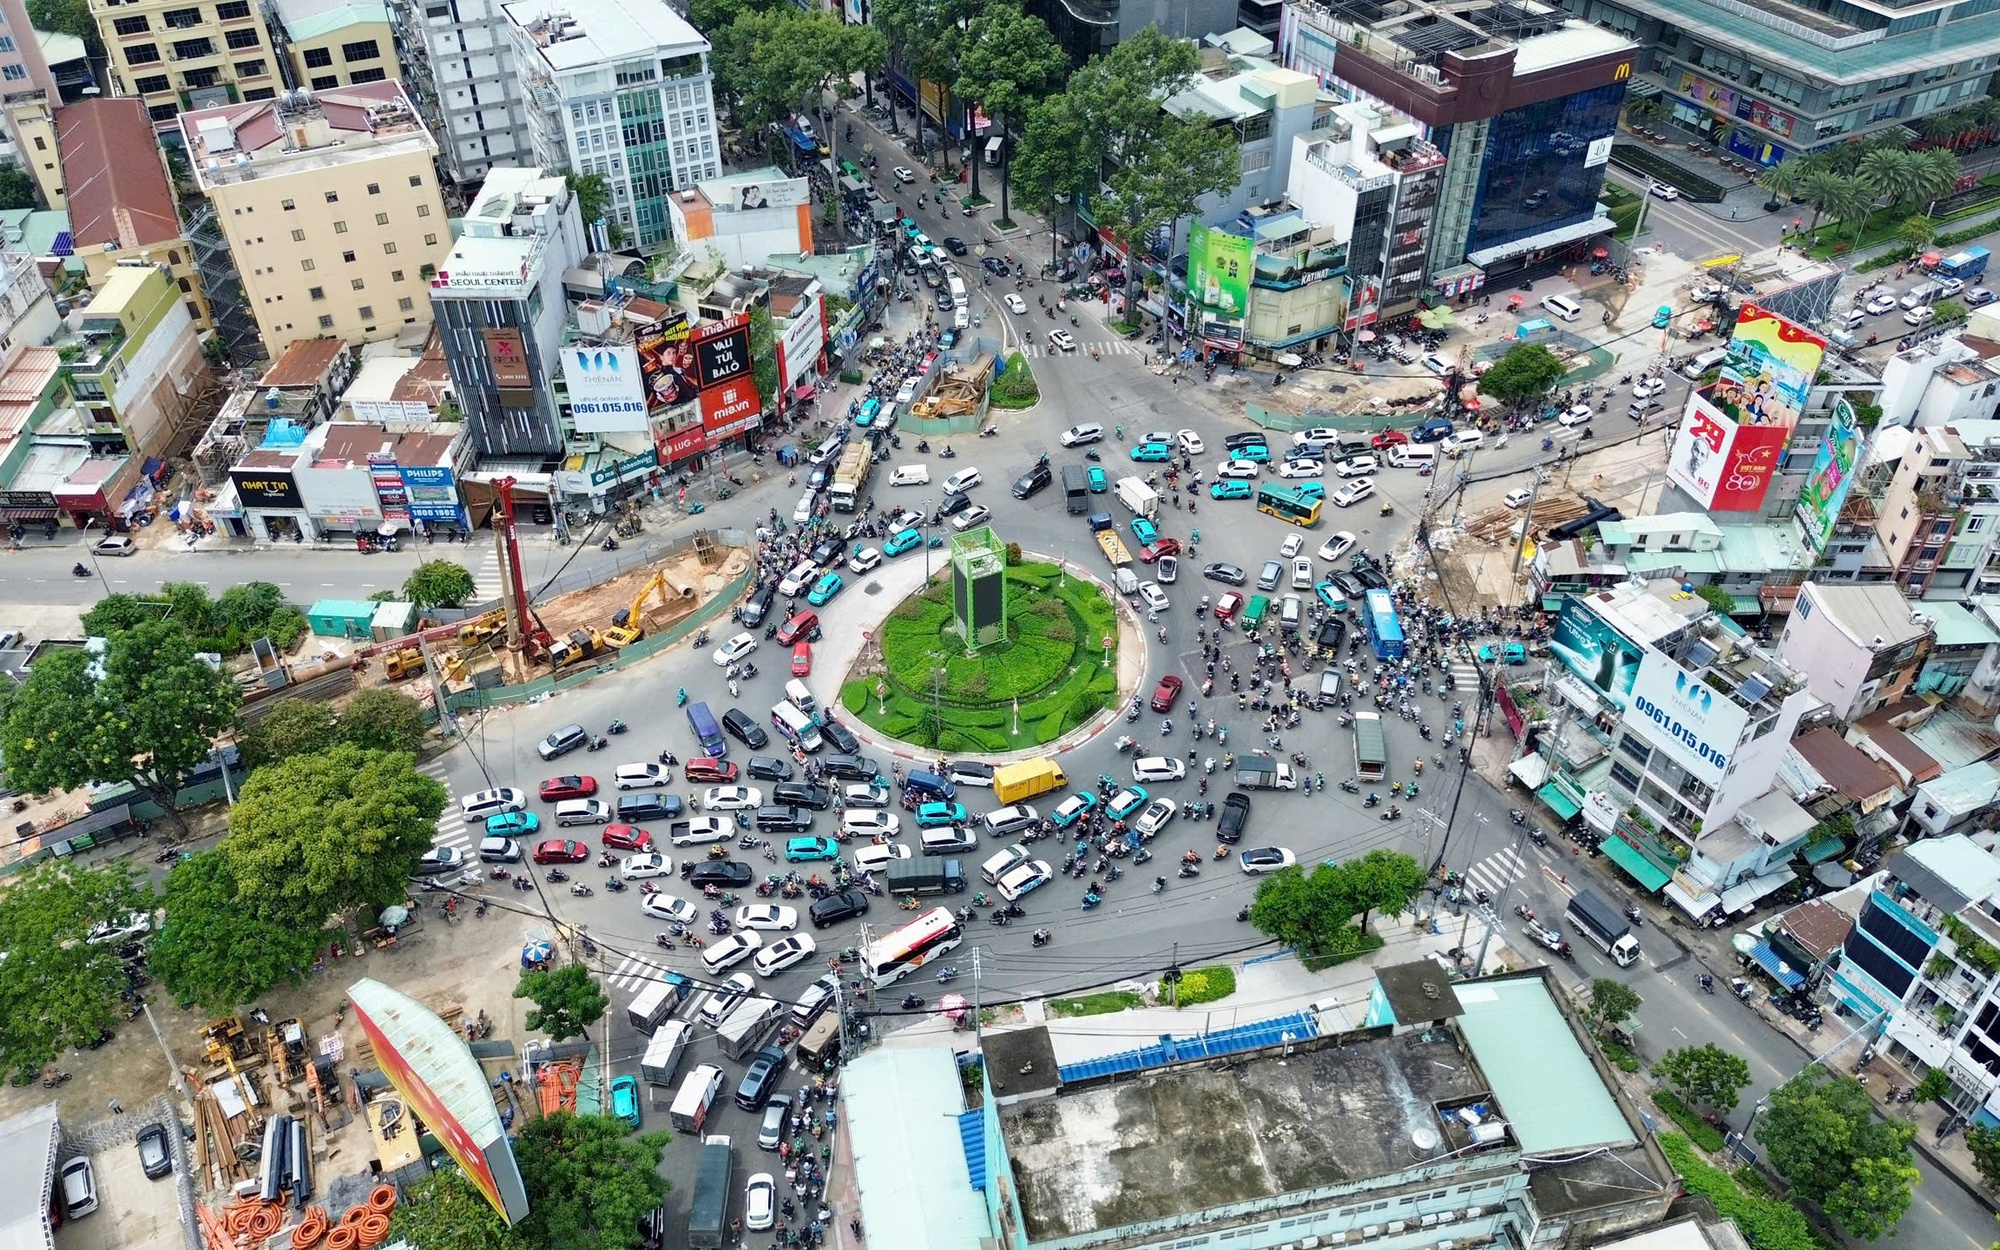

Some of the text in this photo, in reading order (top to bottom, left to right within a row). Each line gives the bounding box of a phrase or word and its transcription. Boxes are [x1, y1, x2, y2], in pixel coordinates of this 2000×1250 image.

[1307, 153, 1324, 169] ANH
[1300, 268, 1330, 285] KATINAT
[702, 317, 740, 337] mia.vn
[796, 314, 815, 336] HONDA
[712, 337, 734, 351] VALI
[715, 351, 733, 364] TÚI
[712, 361, 740, 378] BALÔ
[573, 402, 643, 414] 0961.015.016
[714, 401, 750, 420] mia.vn
[381, 642, 403, 653] SANY
[1635, 695, 1727, 770] 0961.015.016
